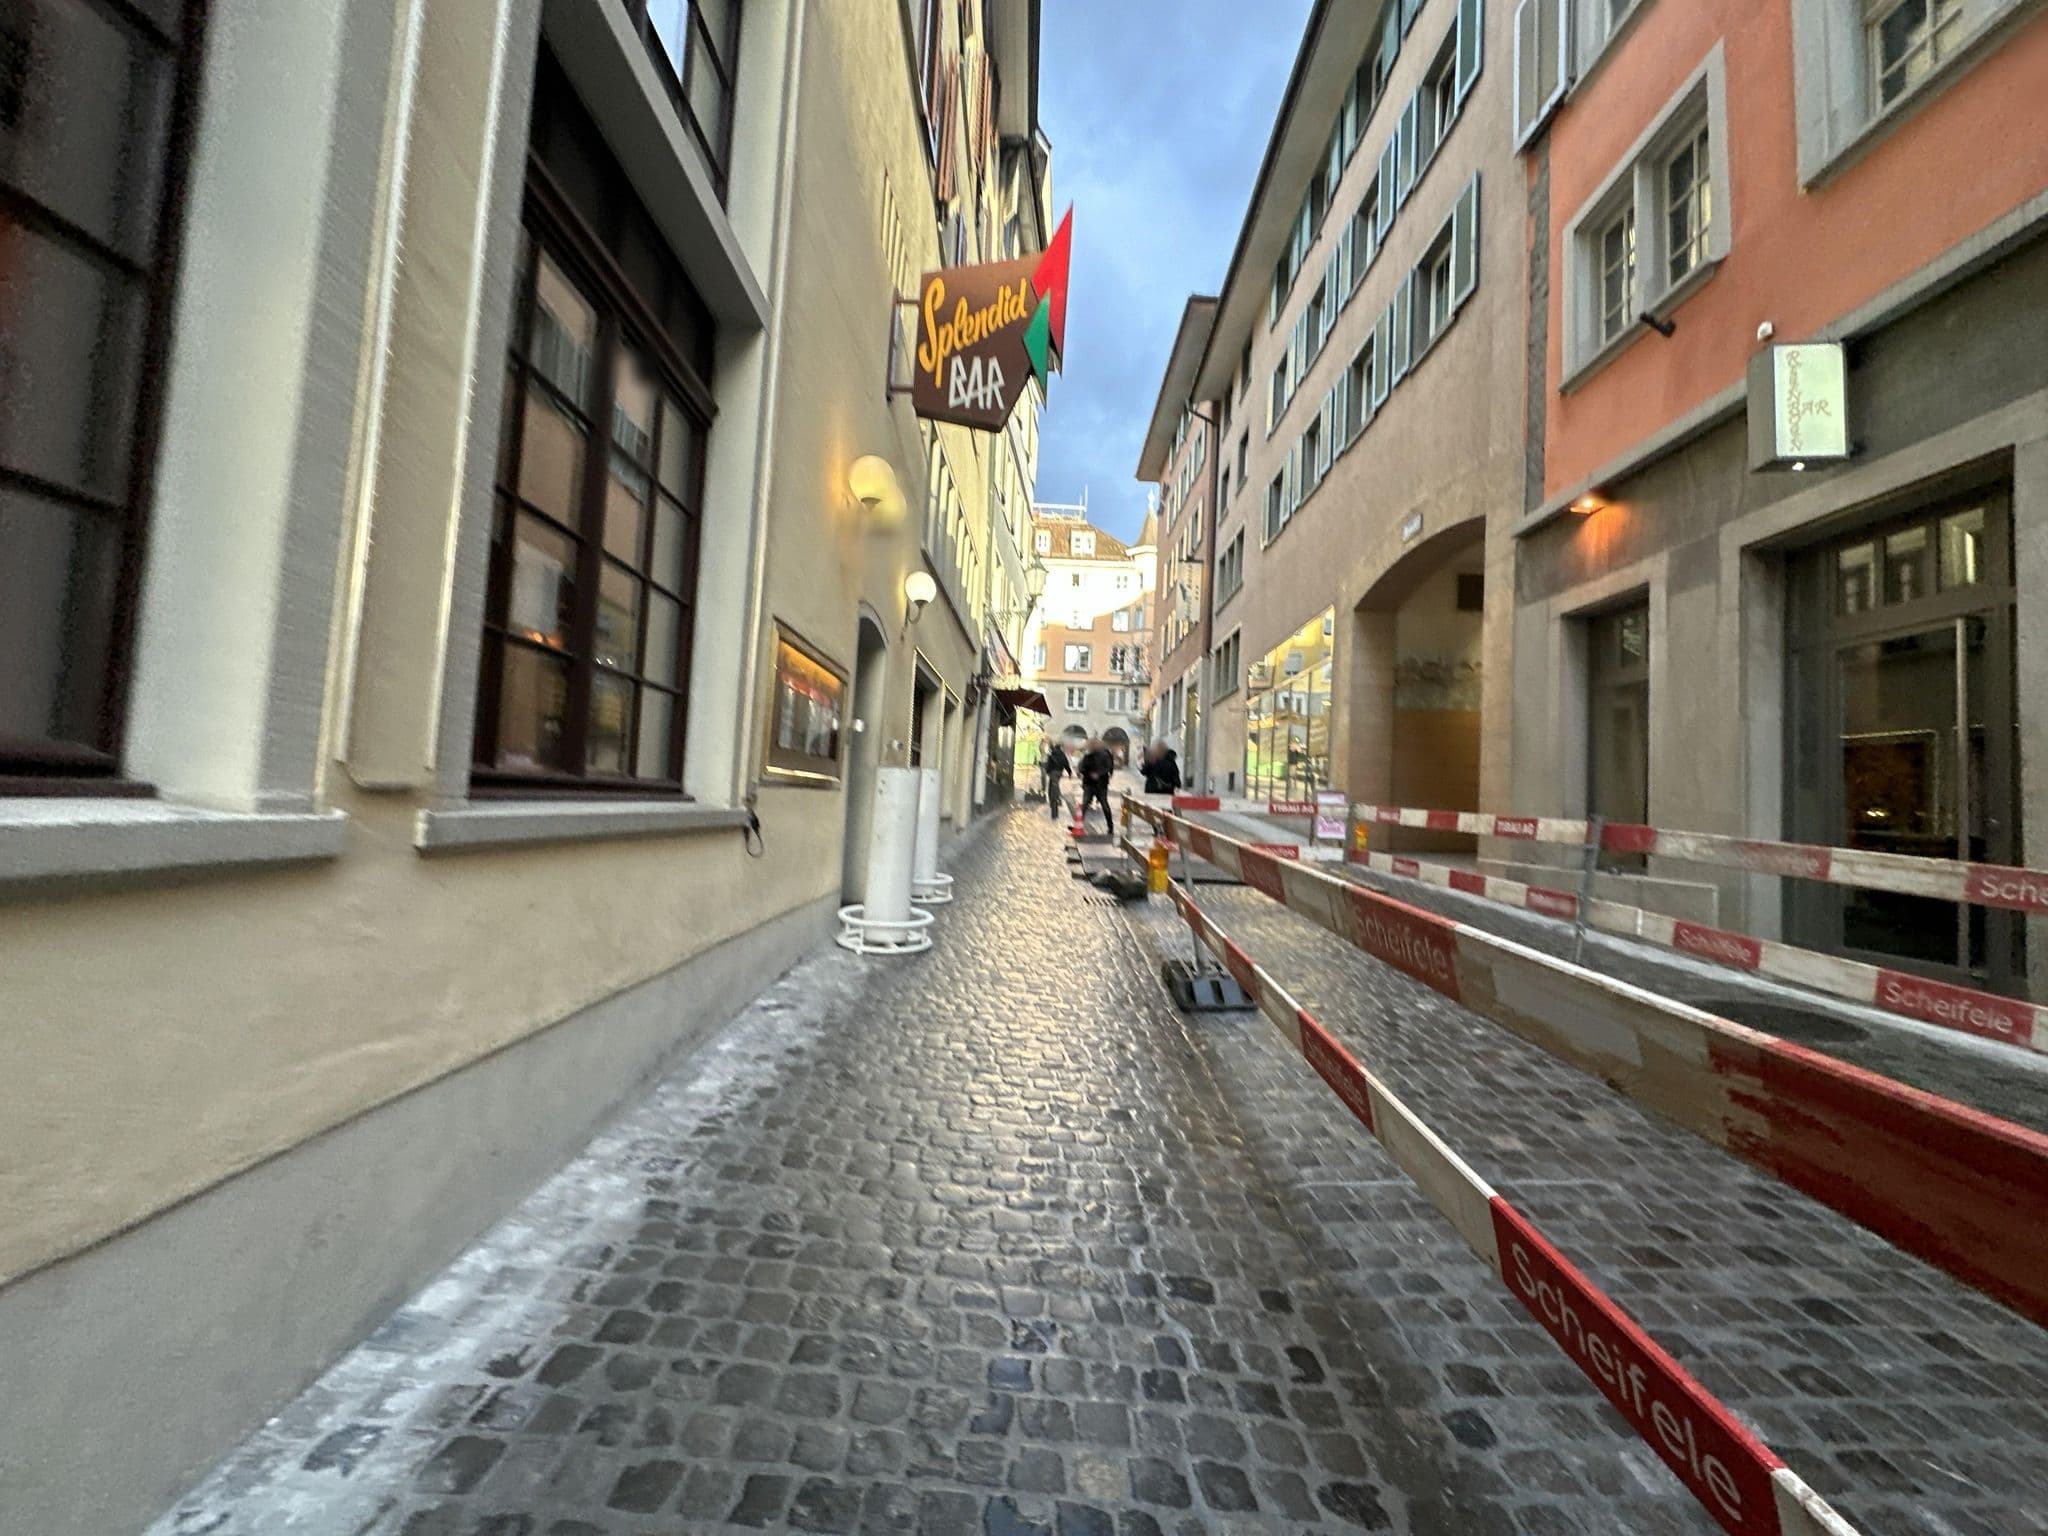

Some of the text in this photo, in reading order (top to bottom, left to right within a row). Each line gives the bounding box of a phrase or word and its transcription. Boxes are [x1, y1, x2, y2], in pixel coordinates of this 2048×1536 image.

[918, 277, 1028, 389] Splendid
[948, 355, 1006, 410] BAR
[1883, 980, 2014, 1035] Scheifele
[1511, 1242, 1742, 1522] Scheifele
